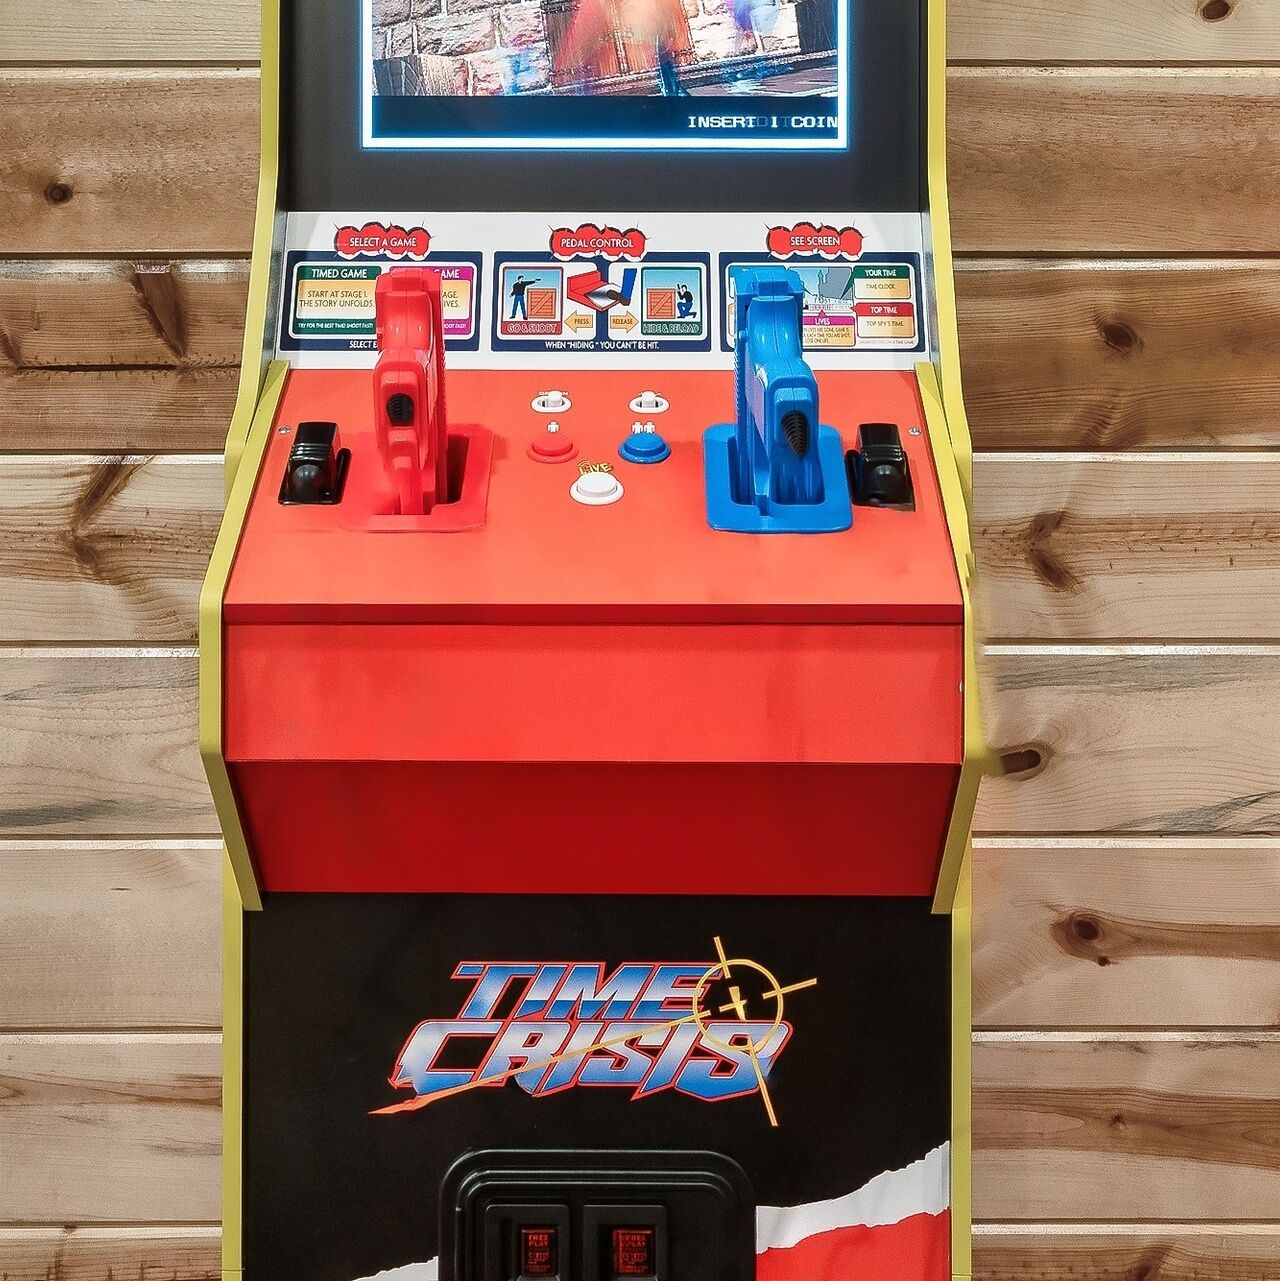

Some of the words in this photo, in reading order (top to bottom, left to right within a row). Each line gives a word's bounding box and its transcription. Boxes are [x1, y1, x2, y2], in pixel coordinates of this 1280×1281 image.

[688, 116, 757, 128] INSERT
[770, 116, 778, 128] 1
[791, 116, 838, 128] COIN
[349, 237, 380, 247] SELECT
[381, 237, 388, 247] A
[390, 237, 417, 247] GAME
[561, 238, 588, 248] PEDAL
[590, 238, 634, 248] CONTROL
[790, 236, 805, 246] SEE
[807, 236, 840, 246] SCREEN
[311, 268, 339, 278] TIMED
[340, 268, 367, 278] GAME
[865, 269, 882, 277] YOUR
[882, 269, 897, 277] TIME
[307, 290, 328, 298] START
[330, 290, 338, 298] AT
[340, 290, 362, 298] STAGE
[299, 300, 314, 308] THE
[314, 300, 338, 308] STORY
[870, 306, 882, 314] TOP
[882, 306, 897, 314] TIME
[814, 318, 830, 326] LIVES
[507, 324, 520, 334] GO
[520, 324, 527, 334] &
[528, 324, 556, 334] SHOOT
[642, 324, 661, 334] HIDE
[661, 324, 669, 334] &
[669, 324, 700, 334] RELOAD
[349, 341, 372, 349] SELECT
[545, 341, 567, 350] WHEN
[600, 341, 615, 350] YOU
[616, 341, 637, 350] CAN'T
[638, 341, 647, 350] BE
[578, 460, 615, 475] LIVE
[451, 961, 722, 1020] TIME
[387, 1019, 793, 1102] CRISIS
